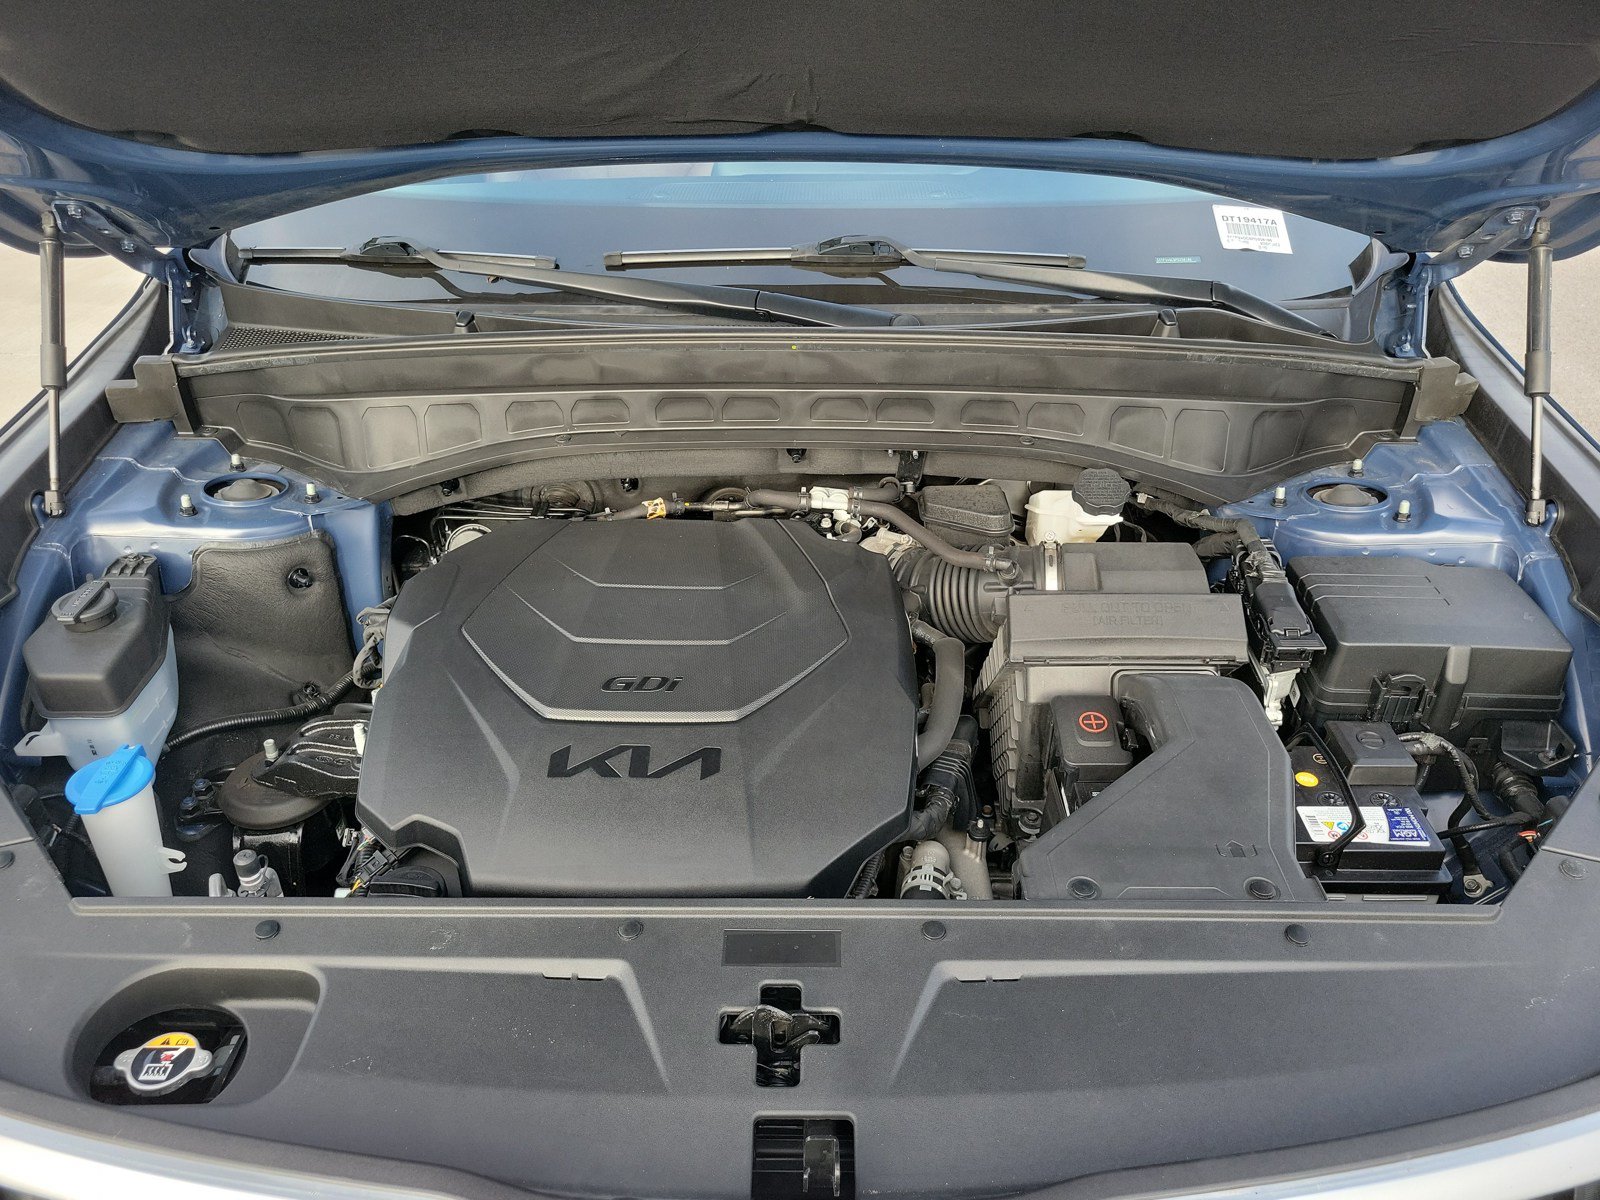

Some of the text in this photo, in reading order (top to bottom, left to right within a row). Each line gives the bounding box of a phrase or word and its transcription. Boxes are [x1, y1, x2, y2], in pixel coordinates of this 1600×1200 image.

[1221, 215, 1277, 226] DT19417A
[1100, 602, 1129, 614] OUT
[1130, 602, 1150, 614] TO
[601, 676, 684, 693] GDi
[547, 744, 722, 780] KIA
